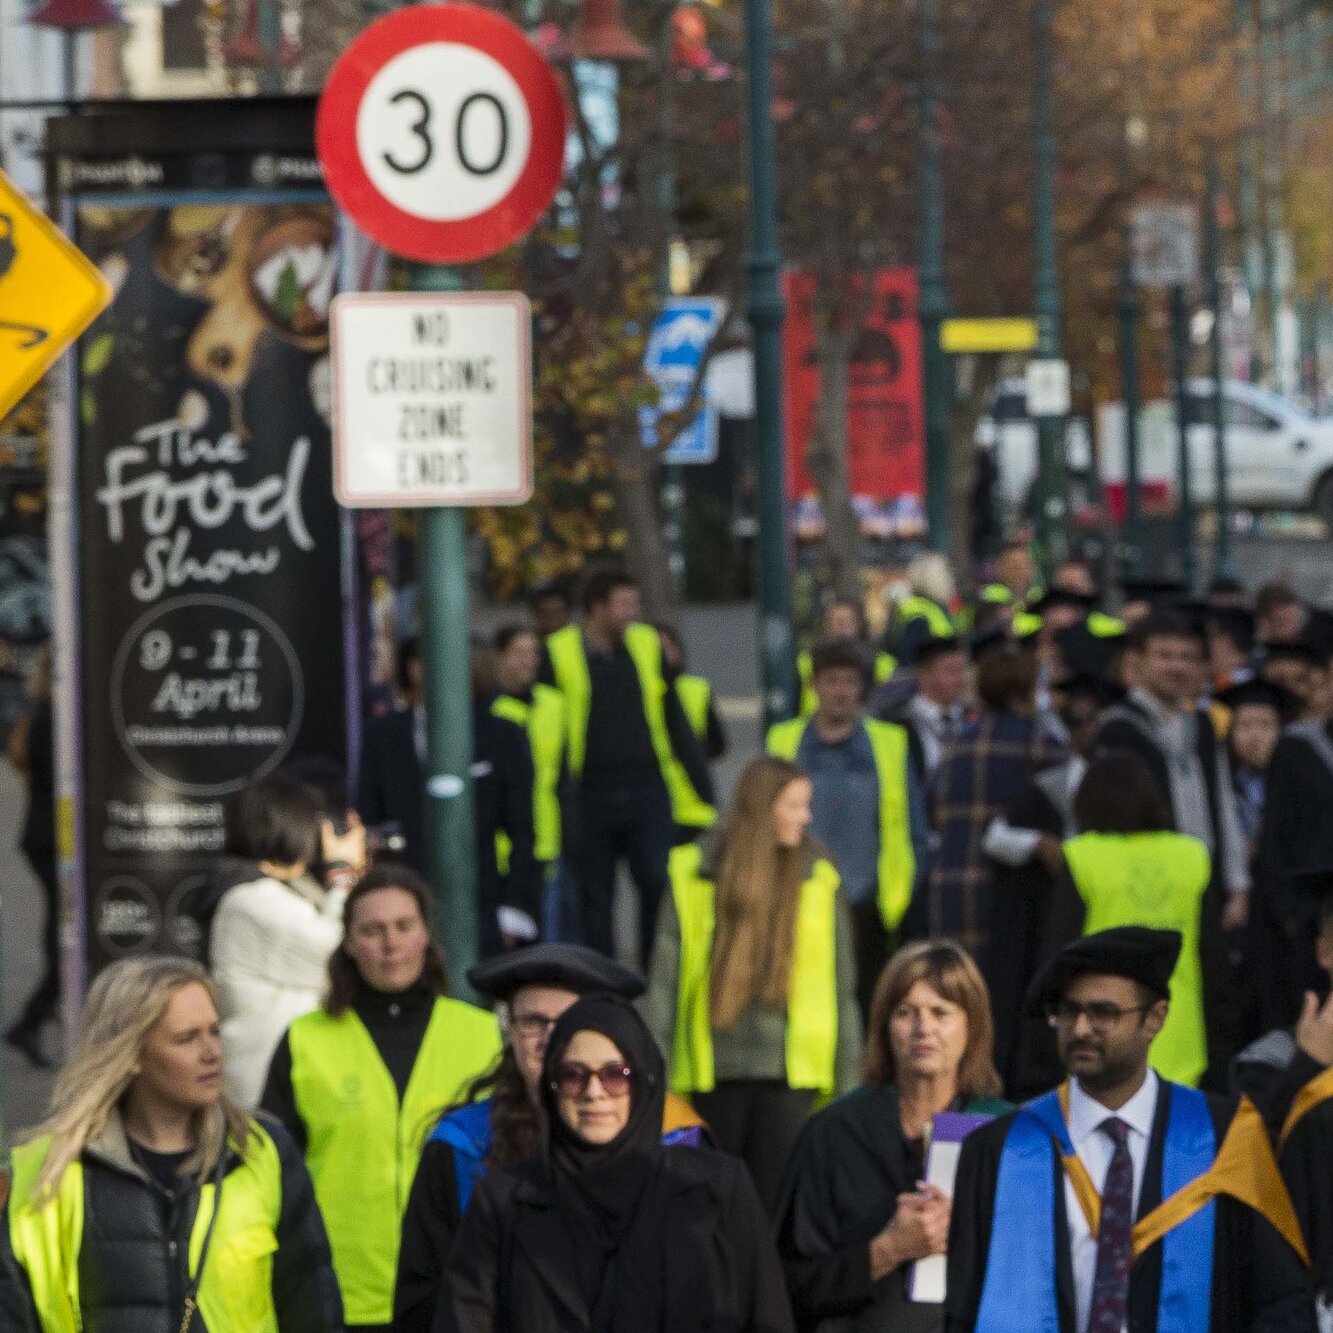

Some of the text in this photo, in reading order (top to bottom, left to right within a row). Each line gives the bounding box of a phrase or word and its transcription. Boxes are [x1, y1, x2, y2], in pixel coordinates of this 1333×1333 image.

[383, 90, 508, 175] 30
[411, 312, 450, 346] NO
[366, 355, 496, 394] CRUISING
[135, 418, 248, 466] The
[398, 402, 466, 442] ZONE
[398, 450, 471, 488] ENDS
[96, 437, 316, 551] Food
[131, 528, 282, 600] Show
[138, 629, 173, 671] 9
[206, 628, 262, 671] 11
[151, 672, 262, 719] April
